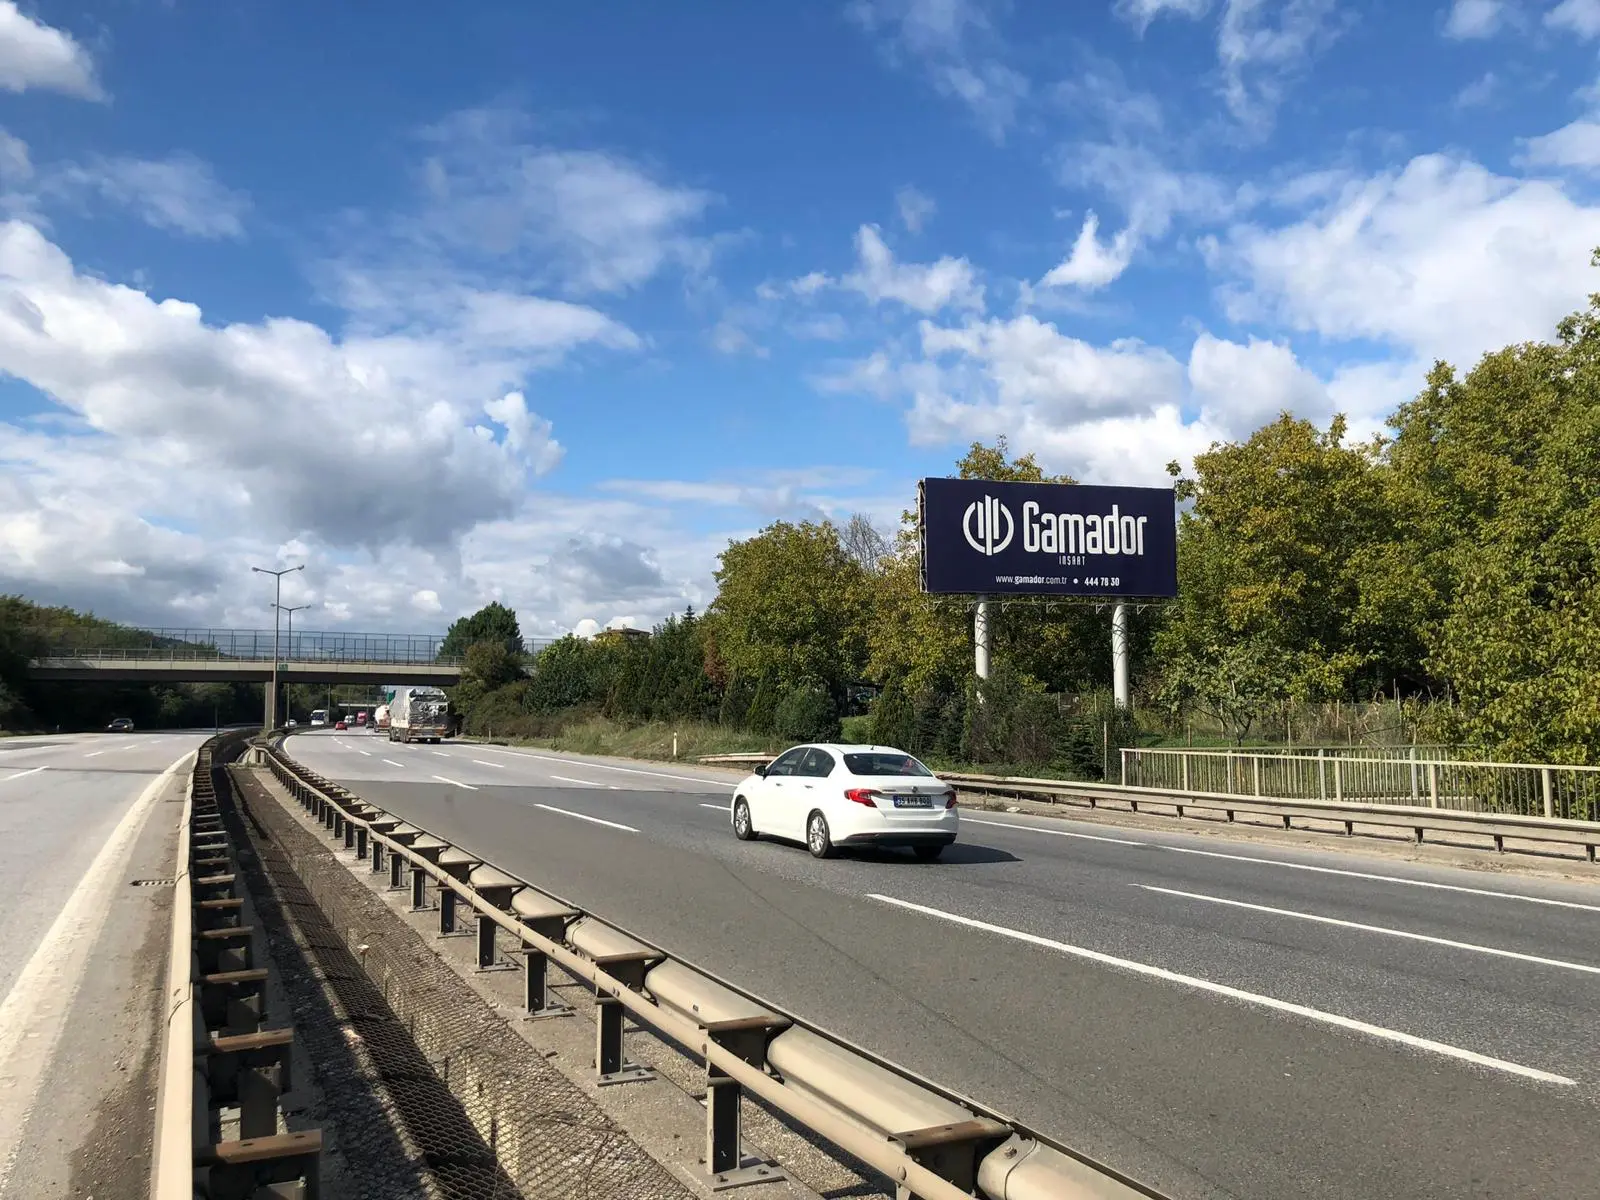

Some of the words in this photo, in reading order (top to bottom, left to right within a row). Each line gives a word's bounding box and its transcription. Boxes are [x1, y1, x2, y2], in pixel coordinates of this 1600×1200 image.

[1022, 500, 1148, 556] Gamador
[995, 575, 1068, 585] www.gamador.com.tr
[1084, 576, 1099, 586] 444
[1110, 577, 1120, 587] 30
